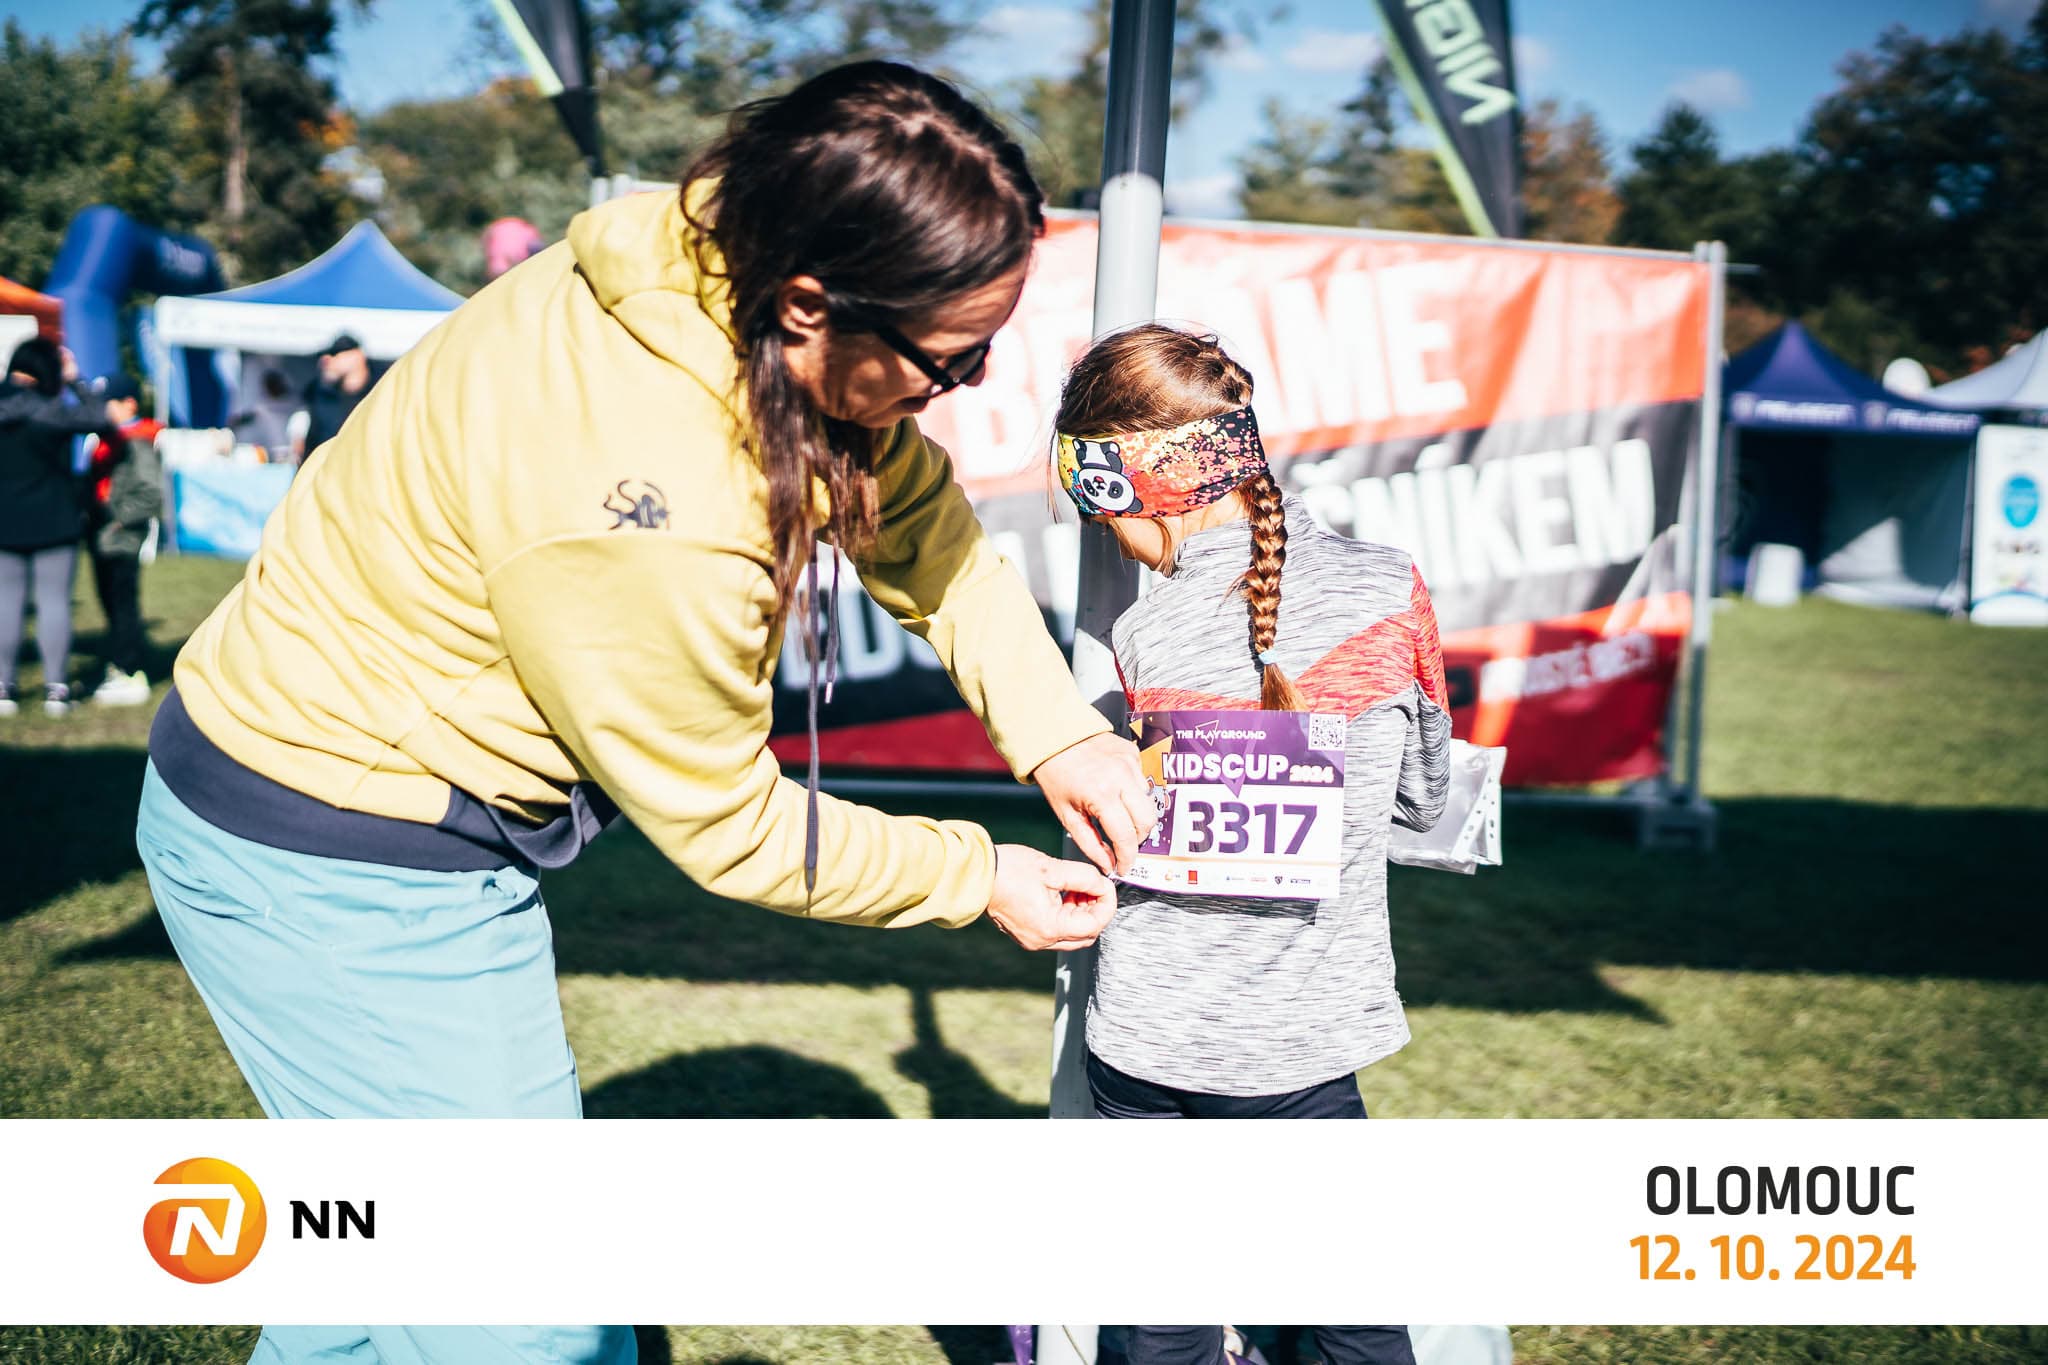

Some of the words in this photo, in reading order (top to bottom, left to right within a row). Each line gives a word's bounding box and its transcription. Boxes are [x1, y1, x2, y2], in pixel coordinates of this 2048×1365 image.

[1175, 730, 1194, 740] THE
[1195, 729, 1267, 741] PLAYGROUND
[1162, 752, 1289, 781] KIDSCUP
[1289, 764, 1335, 784] 2024
[1188, 801, 1318, 855] 3317
